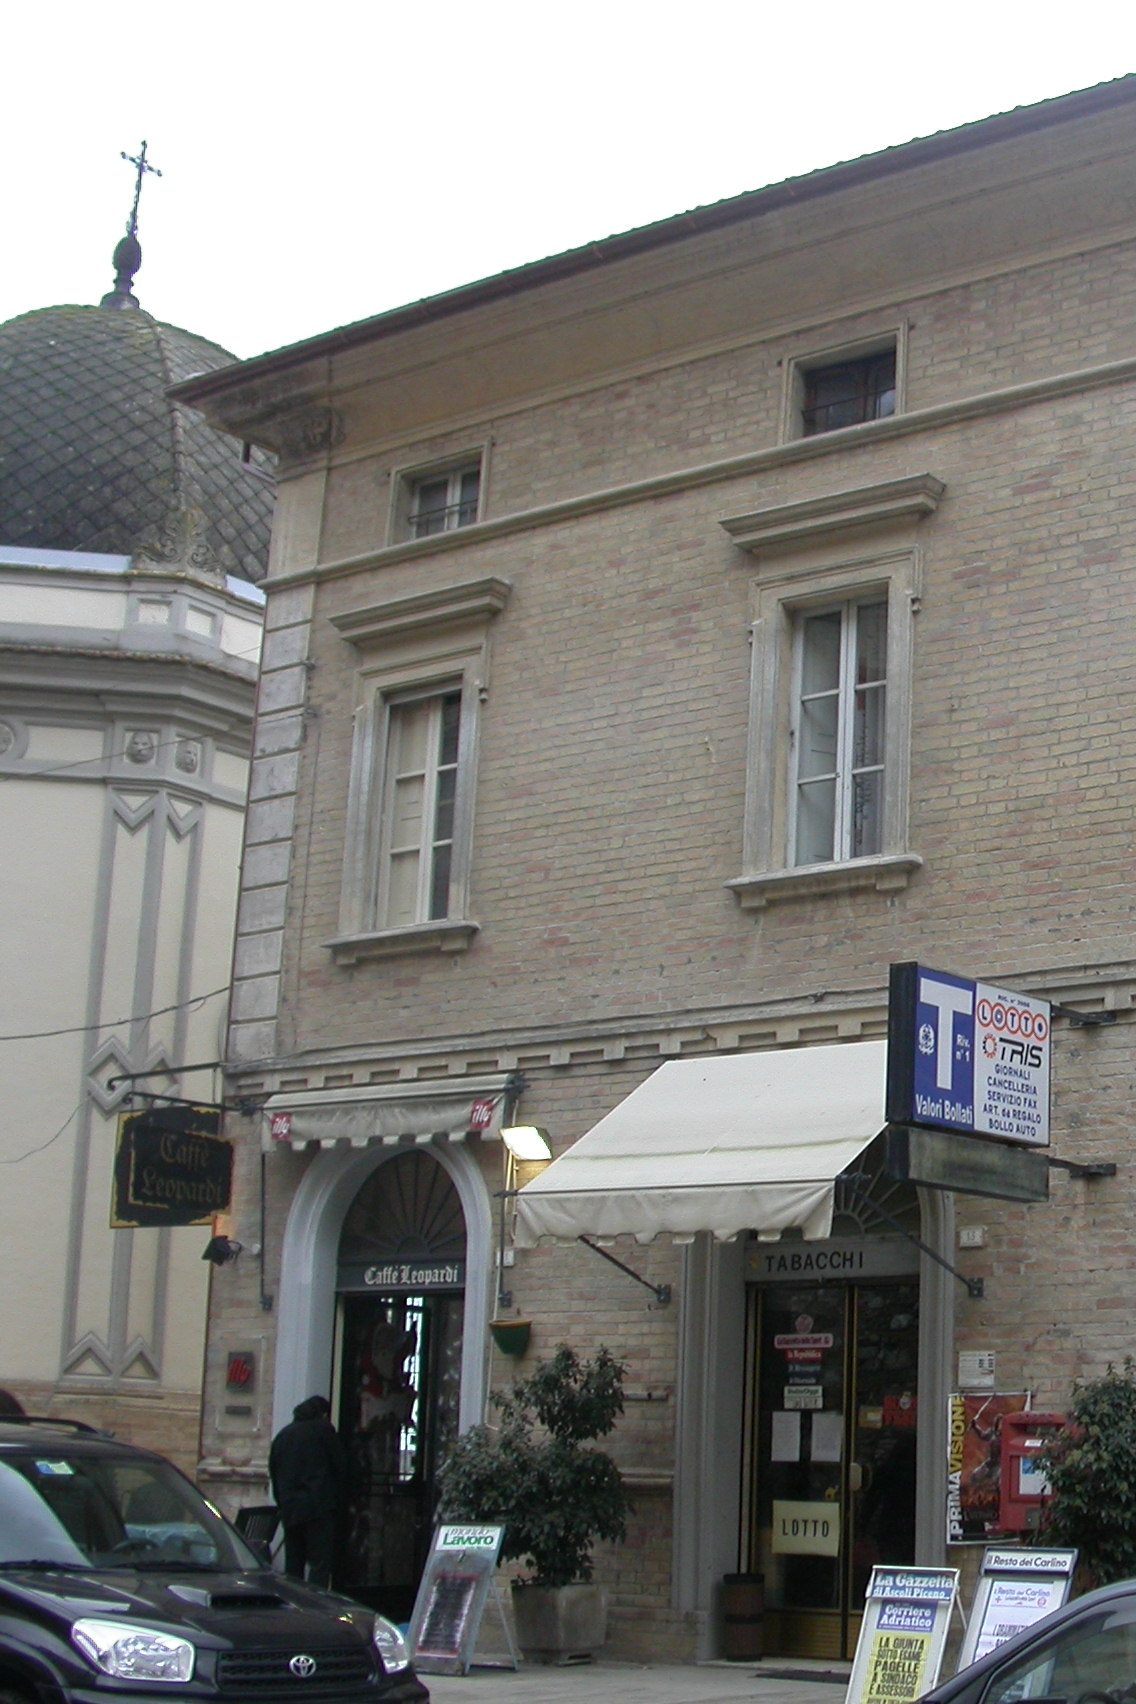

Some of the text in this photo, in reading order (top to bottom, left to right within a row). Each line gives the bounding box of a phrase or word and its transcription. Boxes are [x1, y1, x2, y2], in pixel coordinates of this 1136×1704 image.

[979, 1002, 1046, 1037] LOTTO
[920, 977, 973, 1090] T
[956, 1034, 970, 1048] Riv.
[999, 1037, 1042, 1068] TRIS
[994, 1063, 1030, 1080] GIORNALI
[987, 1076, 1037, 1095] CANCELLERIA
[987, 1090, 1037, 1109] SERVIZIO FAX
[472, 1103, 492, 1123] illy
[916, 1094, 973, 1125] Valori Bollati
[983, 1103, 999, 1115] ART.
[1012, 1111, 1041, 1124] REGALO
[272, 1117, 290, 1135] illy
[989, 1118, 1036, 1137] BOLLO AUTO
[766, 1251, 864, 1272] TABACCHI
[400, 1264, 458, 1284] Leopardi
[781, 1518, 829, 1538] LOTTO
[442, 1532, 494, 1546] Lavoro
[993, 1556, 1018, 1566] Resto
[1019, 1558, 1033, 1567] del
[1034, 1557, 1068, 1568] Carlino
[875, 1572, 953, 1588] La Gazzetta
[873, 1586, 883, 1596] di
[883, 1586, 912, 1597] Ascoli
[885, 1604, 931, 1617] Corriere
[880, 1614, 932, 1628] Adriatico
[880, 1637, 925, 1650] LA GIUNTA
[874, 1661, 920, 1674] PAGELLE
[871, 1672, 918, 1686] A SINDACO
